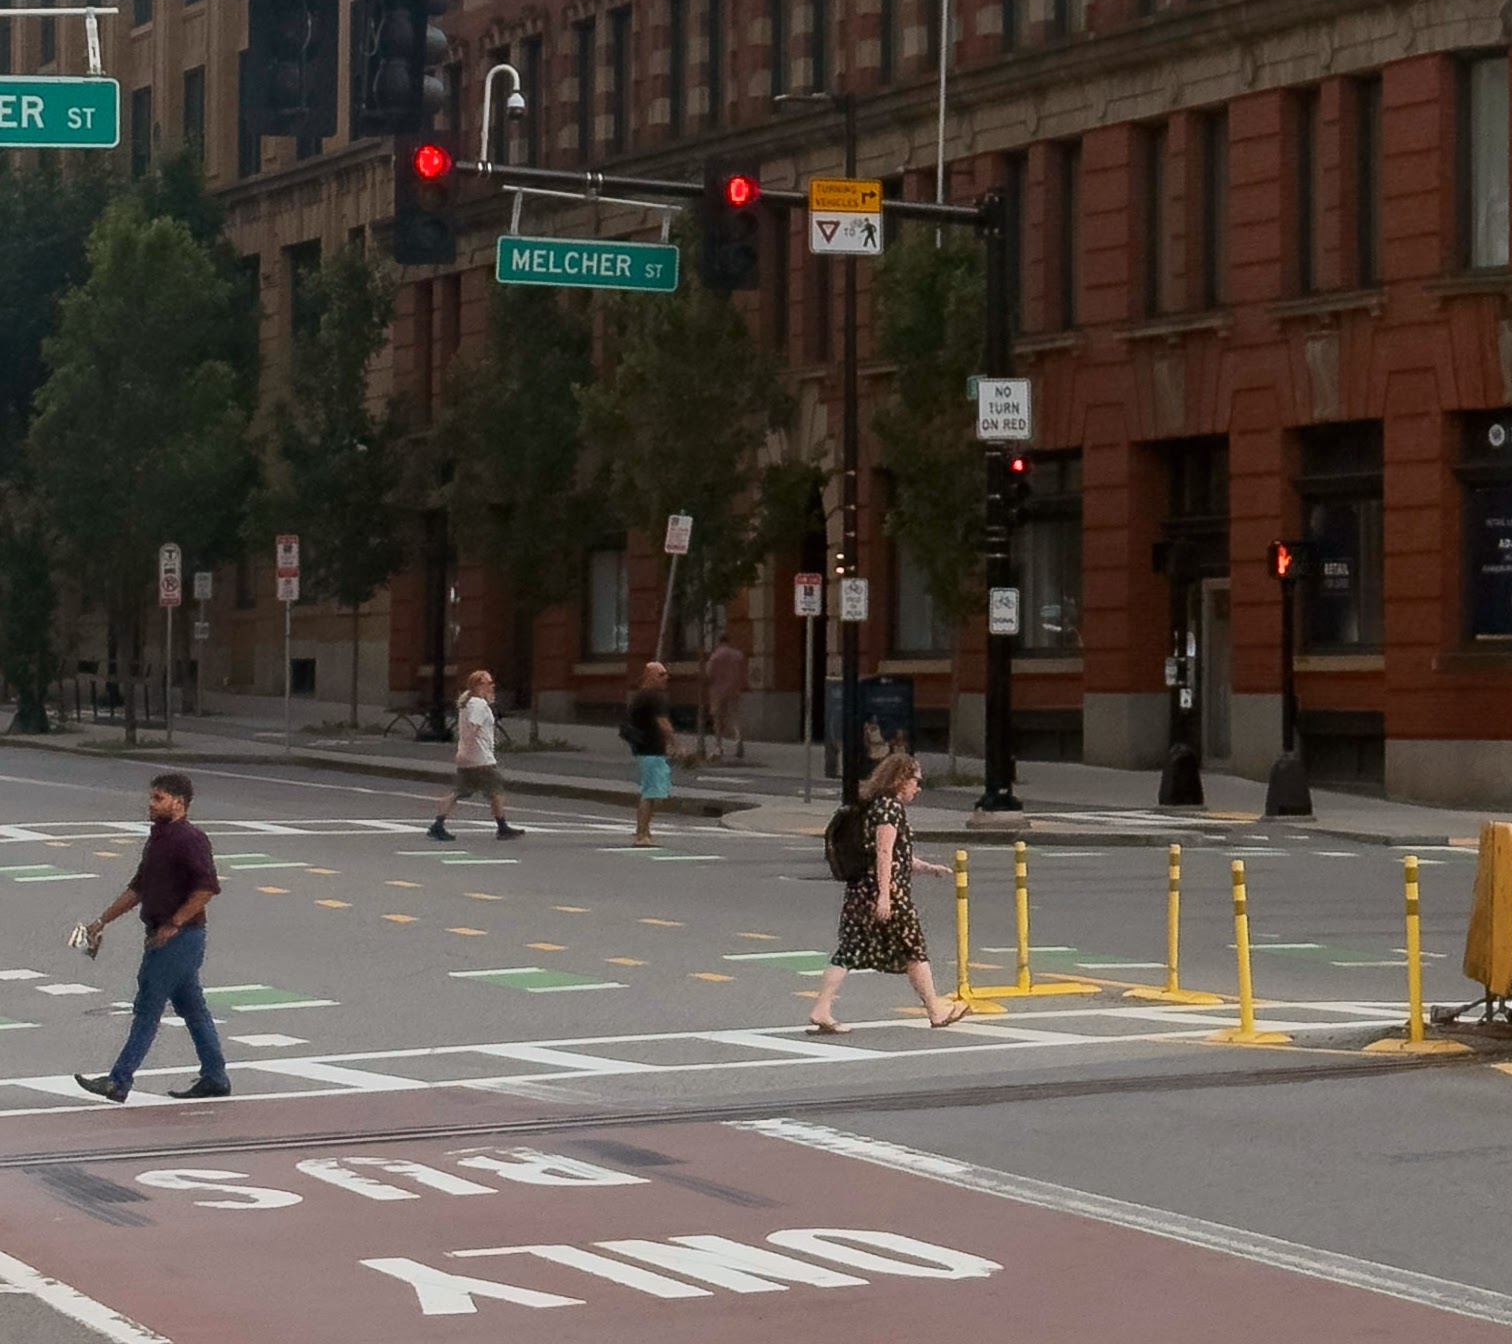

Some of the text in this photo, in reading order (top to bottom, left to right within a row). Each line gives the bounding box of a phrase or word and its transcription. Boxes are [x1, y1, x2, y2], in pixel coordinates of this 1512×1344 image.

[67, 107, 96, 129] ST
[511, 248, 663, 279] MELCHER ST
[995, 386, 1012, 398] NO
[989, 402, 1020, 415] TURN
[982, 418, 1027, 431] ON RED
[359, 1227, 1004, 1315] ONLY
